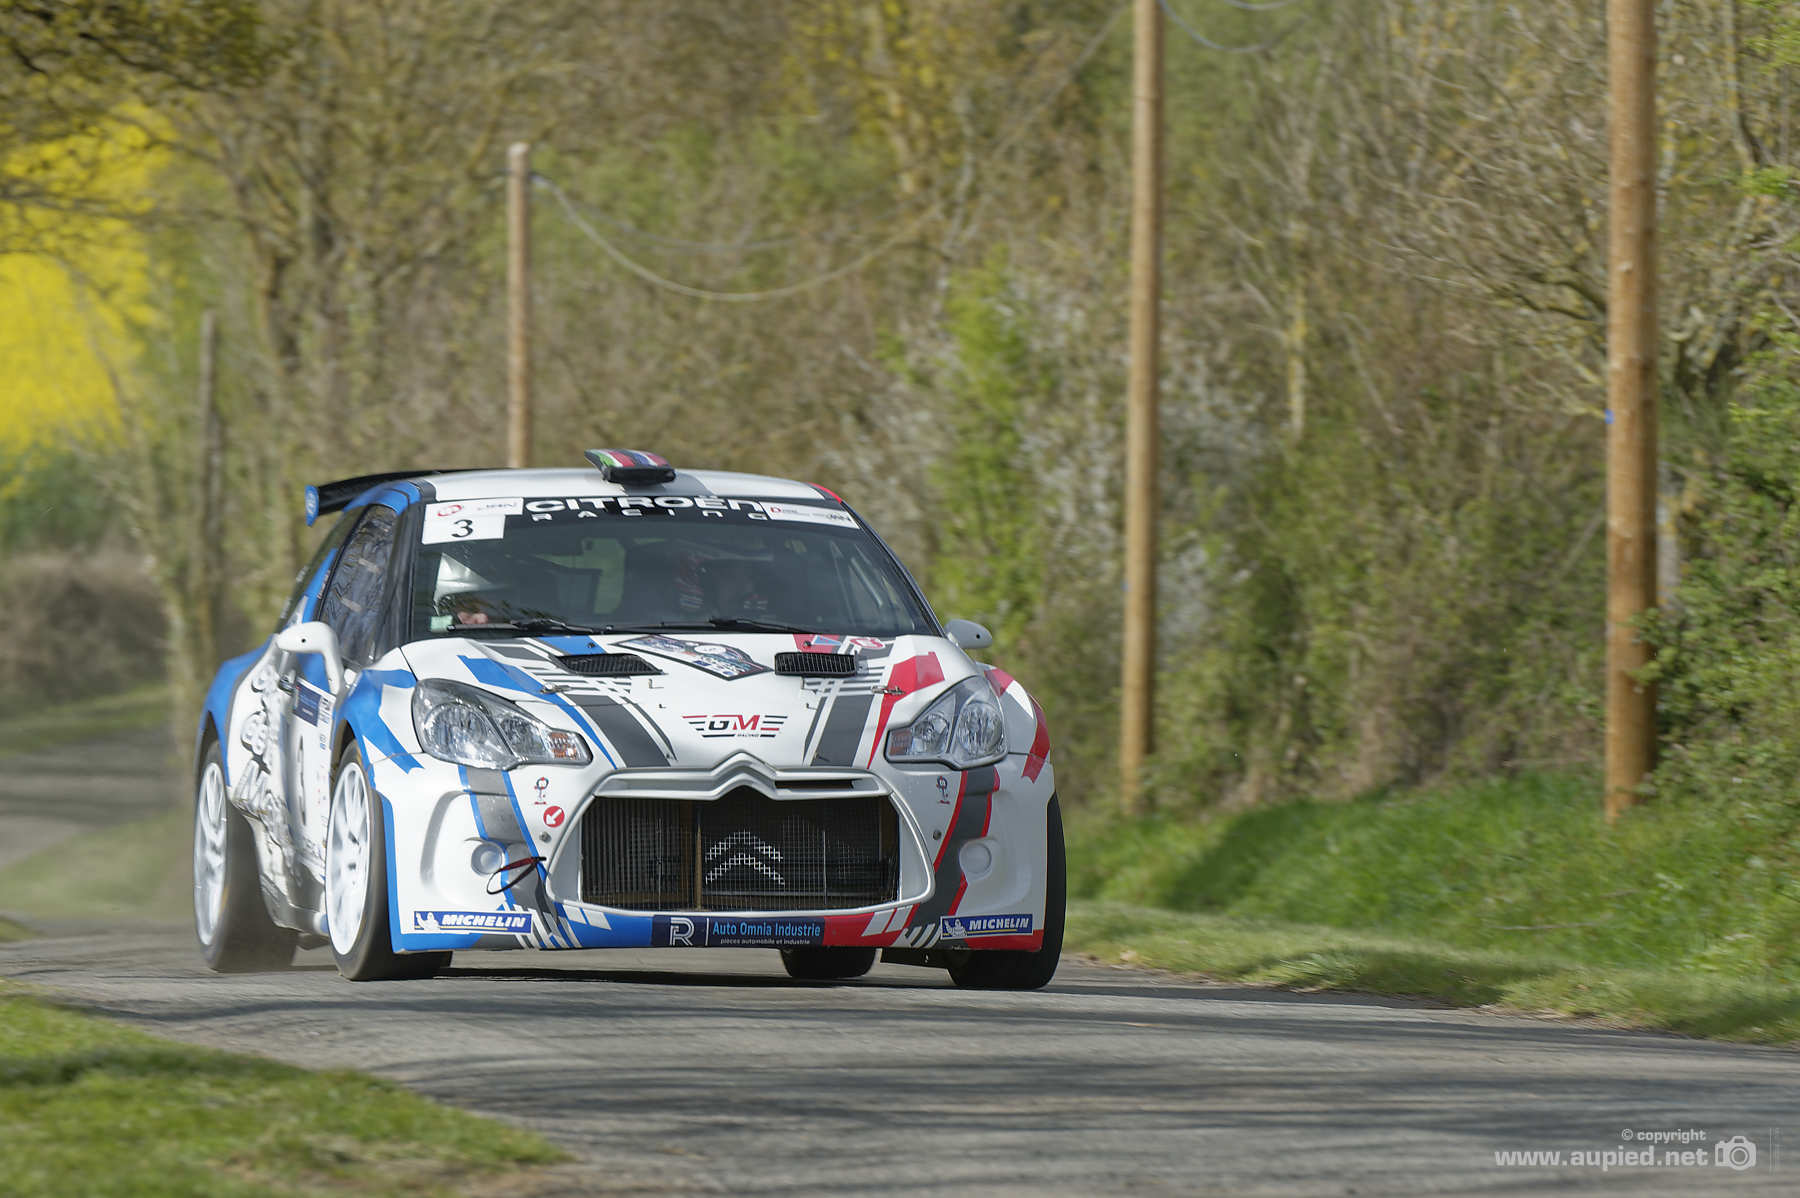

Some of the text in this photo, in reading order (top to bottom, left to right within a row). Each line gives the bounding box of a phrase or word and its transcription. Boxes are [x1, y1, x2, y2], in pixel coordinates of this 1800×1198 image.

[532, 508, 768, 522] RACING
[451, 519, 474, 538] 3
[441, 914, 526, 928] MICHELIN
[969, 917, 1029, 931] MICHELIN
[712, 921, 821, 937] Auto Omnia Industrie
